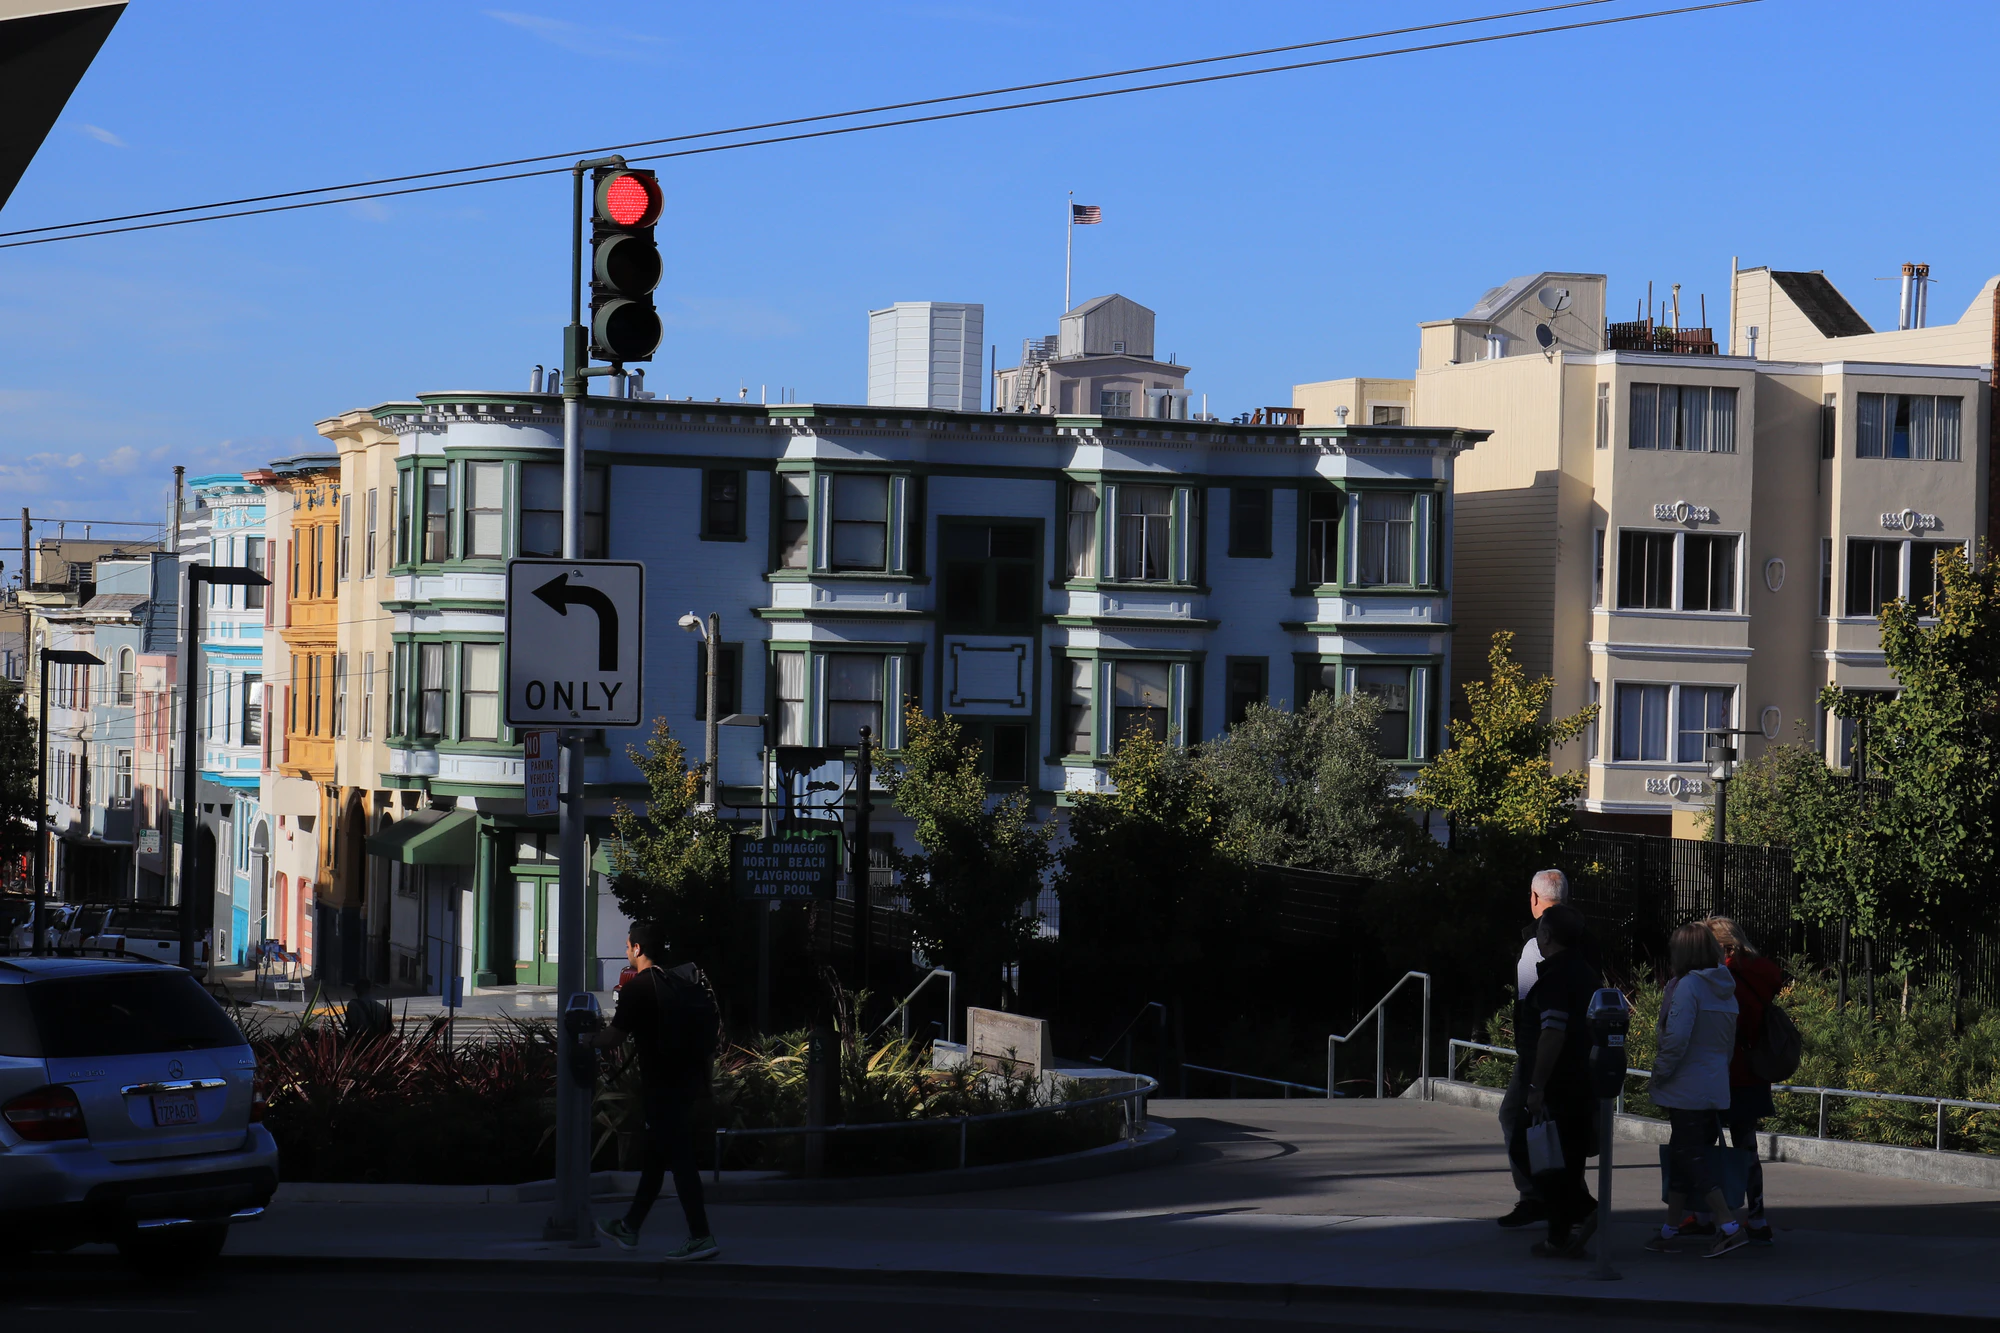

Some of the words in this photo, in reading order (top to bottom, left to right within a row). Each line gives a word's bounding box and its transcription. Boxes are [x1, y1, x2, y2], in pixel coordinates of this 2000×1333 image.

[525, 680, 623, 711] ONLY
[526, 736, 539, 755] NO
[530, 759, 554, 771] PARKING
[529, 773, 555, 784] VEHICLES
[532, 787, 546, 797] OVER
[537, 799, 550, 810] HIGH
[742, 842, 764, 853] JOE
[772, 843, 826, 854] DIMAGGIO
[742, 856, 779, 867] NORTH
[788, 857, 826, 868] BEACH
[746, 870, 821, 881] PLAYGROUND
[753, 884, 777, 895] AND
[783, 884, 813, 895] POOL
